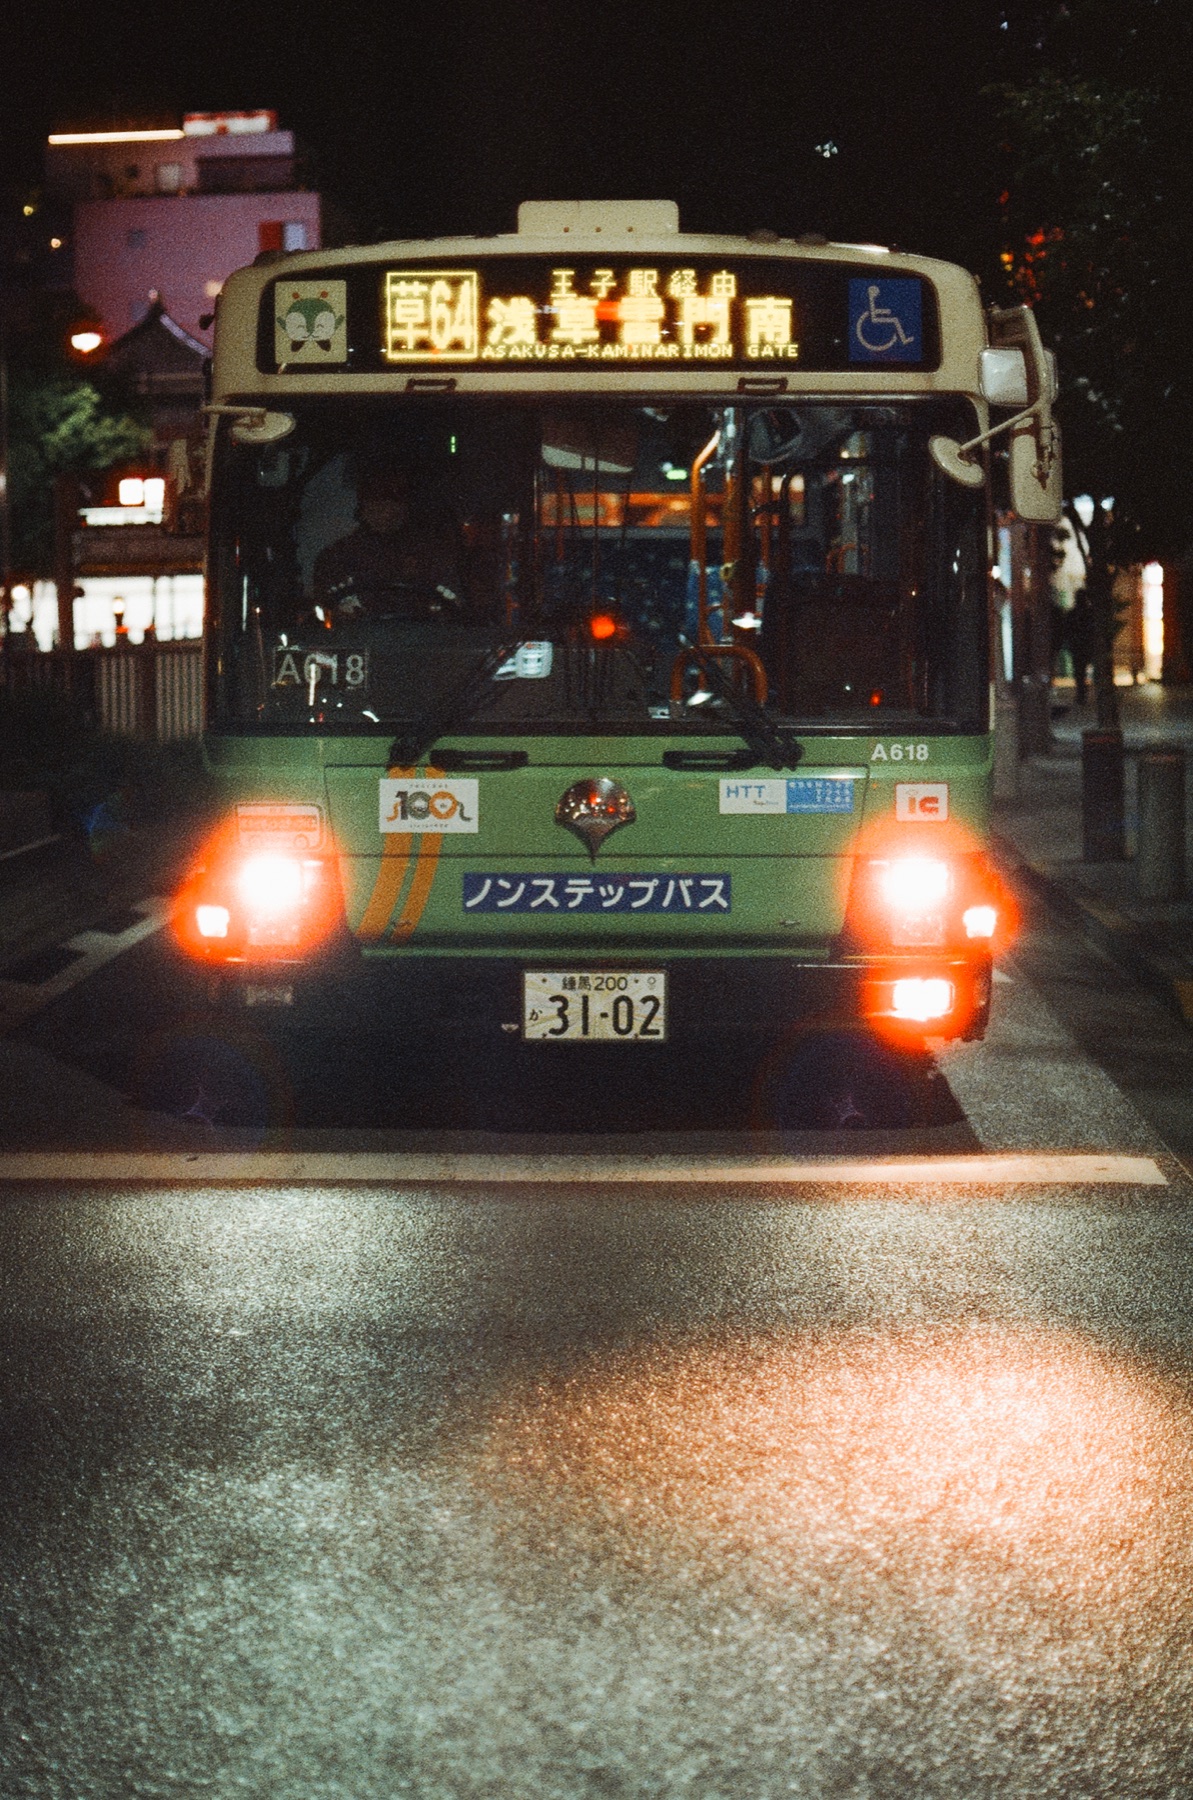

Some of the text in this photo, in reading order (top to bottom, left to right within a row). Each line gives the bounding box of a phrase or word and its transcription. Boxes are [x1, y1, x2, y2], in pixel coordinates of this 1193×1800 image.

[551, 269, 737, 299] 王子駅経由
[391, 280, 472, 350] 草64
[482, 344, 798, 358] ASAKUSA-KAMINARIMON GATE
[871, 743, 930, 762] A618
[725, 785, 767, 799] HTT
[465, 878, 729, 909] ノンステップバス
[594, 976, 629, 991] 200
[548, 994, 661, 1036] 31-02
